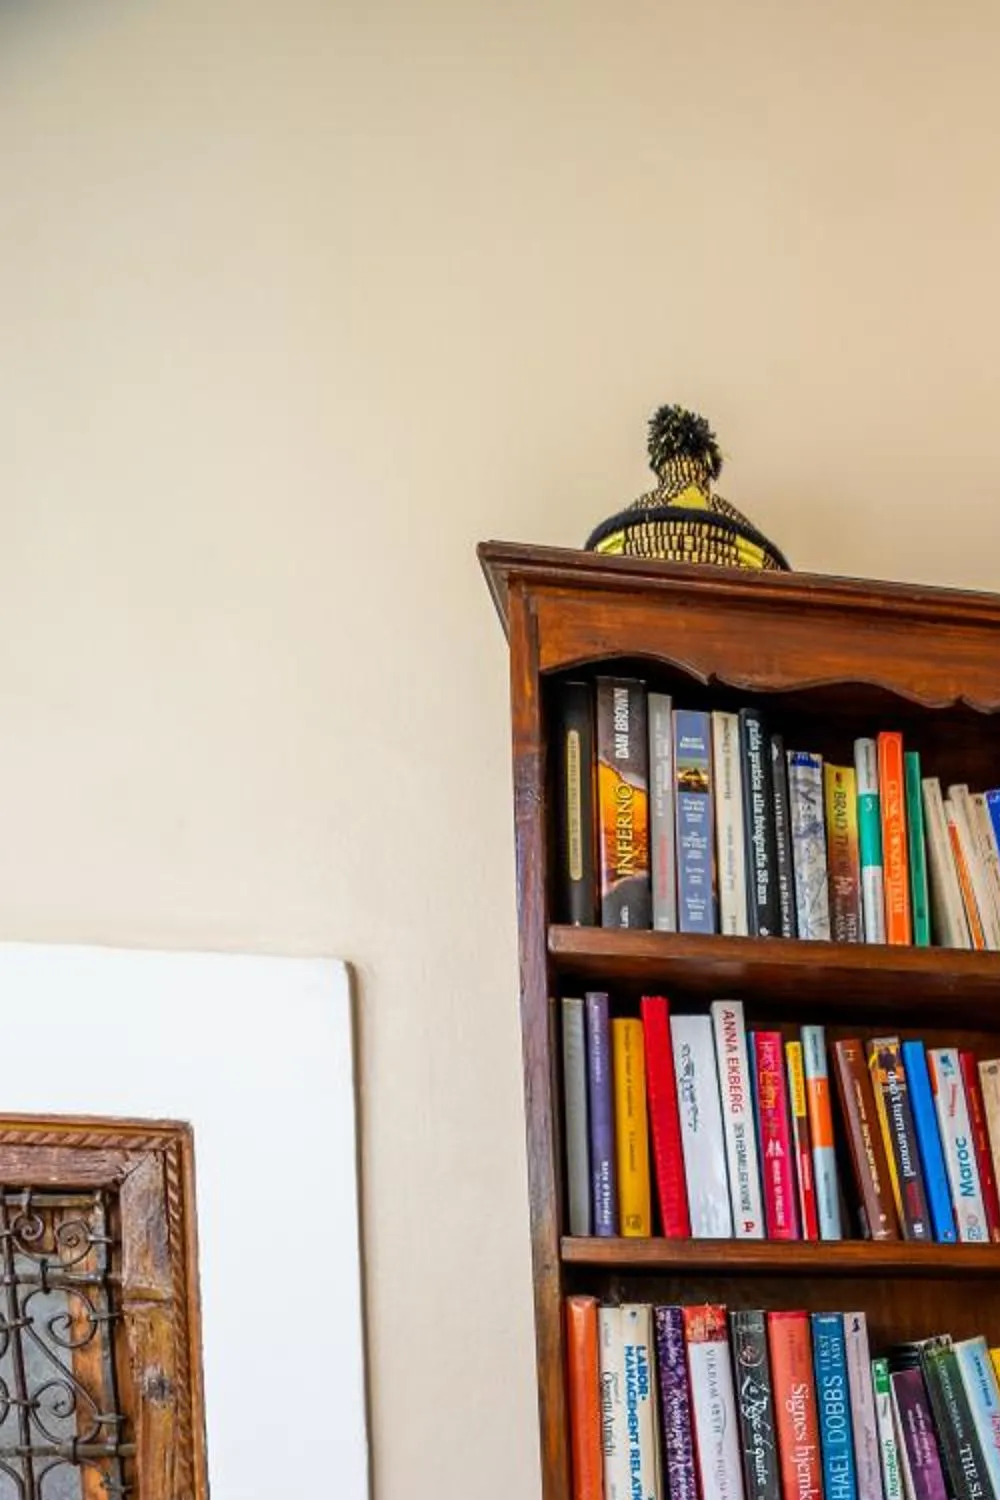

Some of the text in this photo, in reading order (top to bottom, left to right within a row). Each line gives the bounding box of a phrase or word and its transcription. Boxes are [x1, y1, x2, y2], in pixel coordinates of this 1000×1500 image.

[612, 687, 630, 759] DAN BROWN
[615, 781, 634, 876] INFERNO
[745, 719, 769, 905] guida pratica alla fotografia 35 mm
[833, 791, 847, 829] BRAD
[722, 1009, 744, 1115] ANNA EKBERG
[887, 1071, 916, 1178] don't turn around
[956, 1136, 976, 1198] Maroc
[635, 1345, 649, 1401] LABOR-
[704, 1348, 718, 1398] VIKRAM
[818, 1333, 831, 1371] FIRST
[829, 1334, 842, 1369] LADY
[624, 1345, 640, 1444] MANAGEMENT
[785, 1382, 810, 1441] Signes
[823, 1375, 847, 1443] DOBBS
[745, 1448, 769, 1486] quatre
[885, 1439, 899, 1498] Marrakech
[958, 1443, 977, 1482] THE
